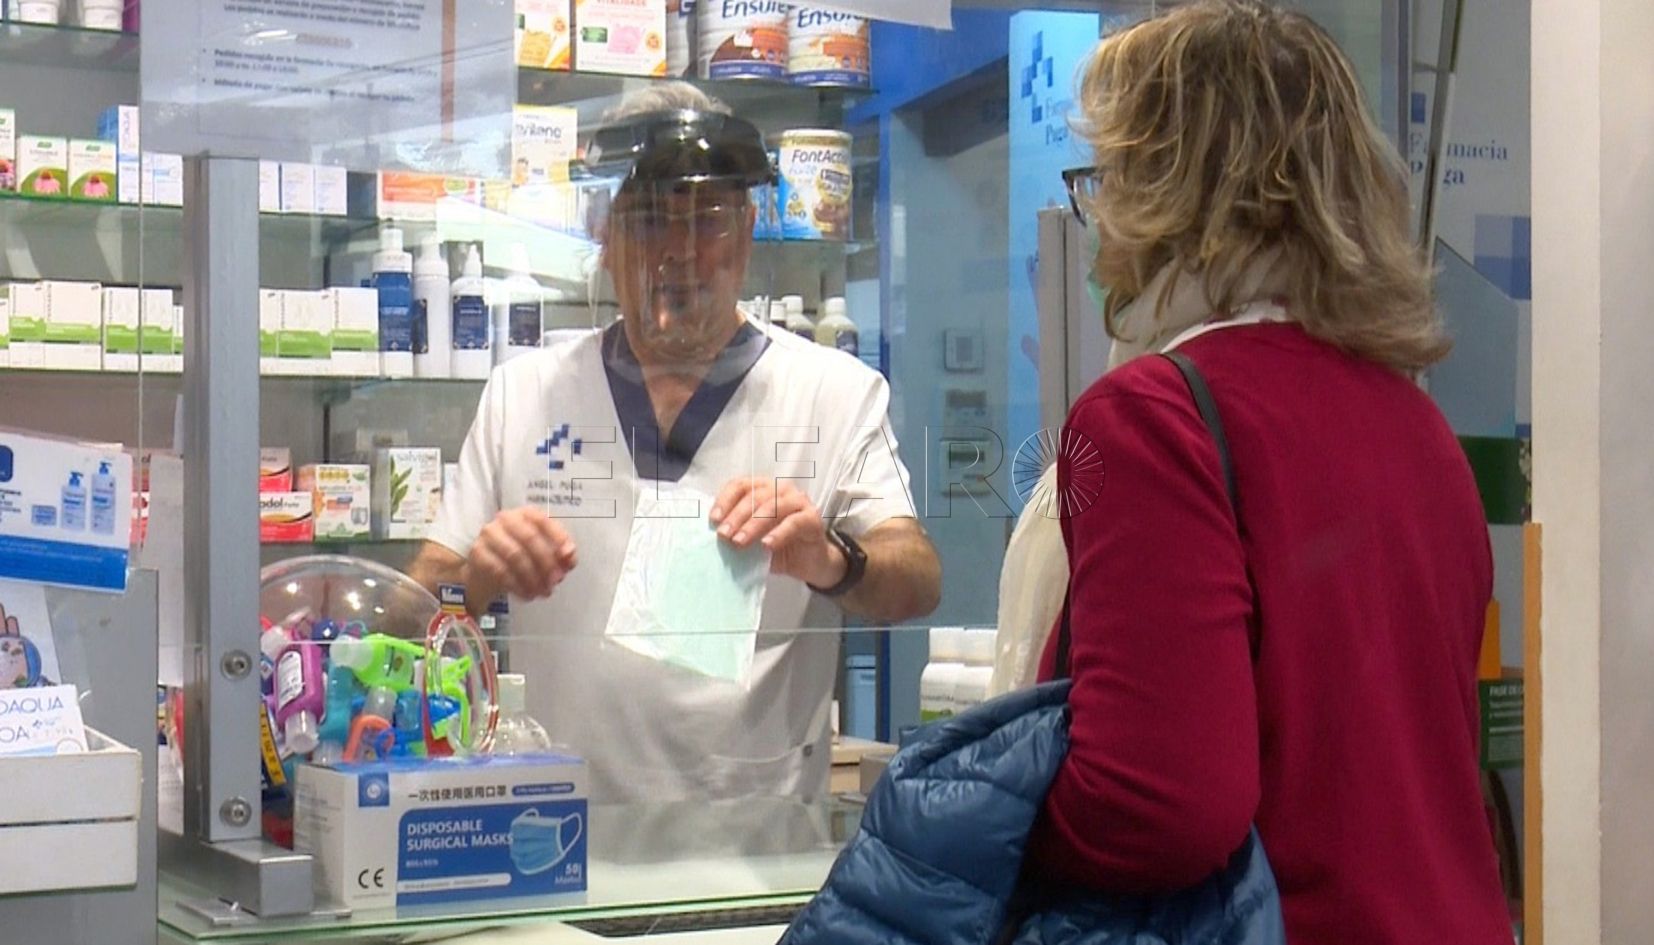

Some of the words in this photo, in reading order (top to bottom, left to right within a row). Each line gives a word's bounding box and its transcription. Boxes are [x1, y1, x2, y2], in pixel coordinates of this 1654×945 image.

[1410, 159, 1465, 191] Pga
[407, 819, 483, 836] DISPOSABLE
[407, 836, 469, 852] SURGICAL
[471, 832, 514, 848] MASKS
